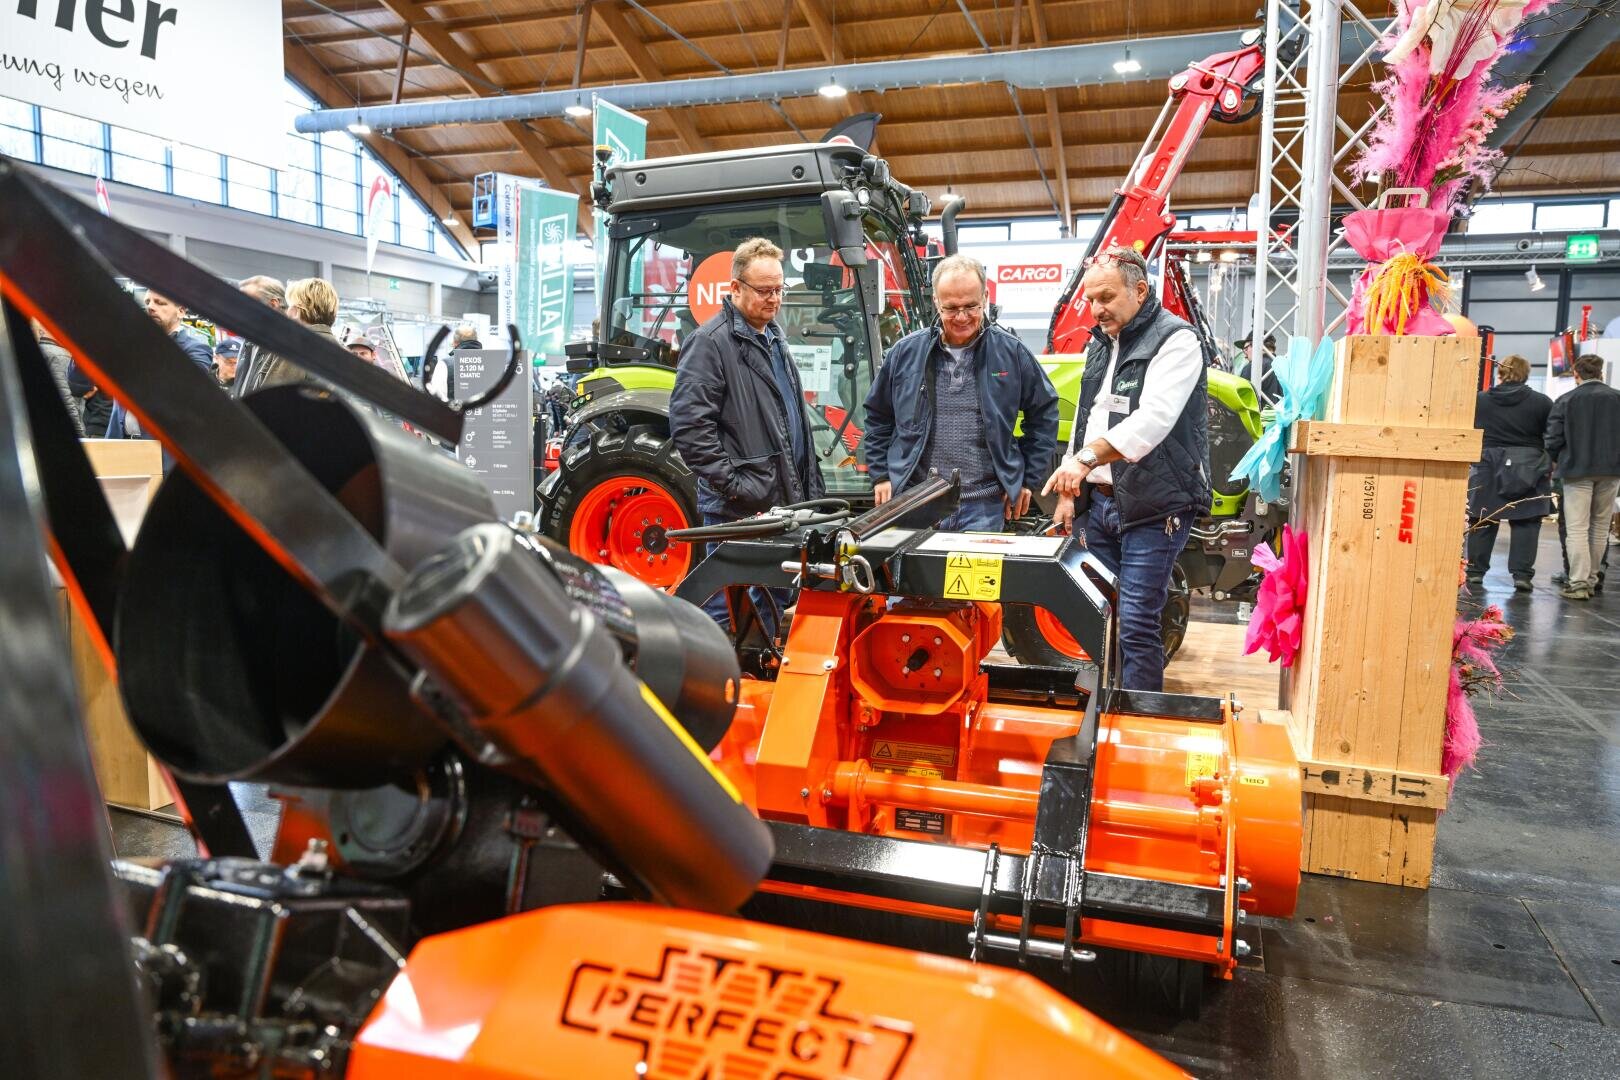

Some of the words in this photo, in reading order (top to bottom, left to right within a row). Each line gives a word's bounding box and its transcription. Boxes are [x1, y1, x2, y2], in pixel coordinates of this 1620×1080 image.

[0, 54, 65, 92] ung
[74, 68, 164, 104] wegen
[696, 282, 732, 305] NE
[1000, 266, 1060, 281] CARGO
[459, 364, 477, 372] 2.120
[477, 364, 485, 372] M
[1362, 475, 1375, 520] 12571690
[1398, 480, 1417, 544] CLAAS
[590, 984, 876, 1070] PERFECT
